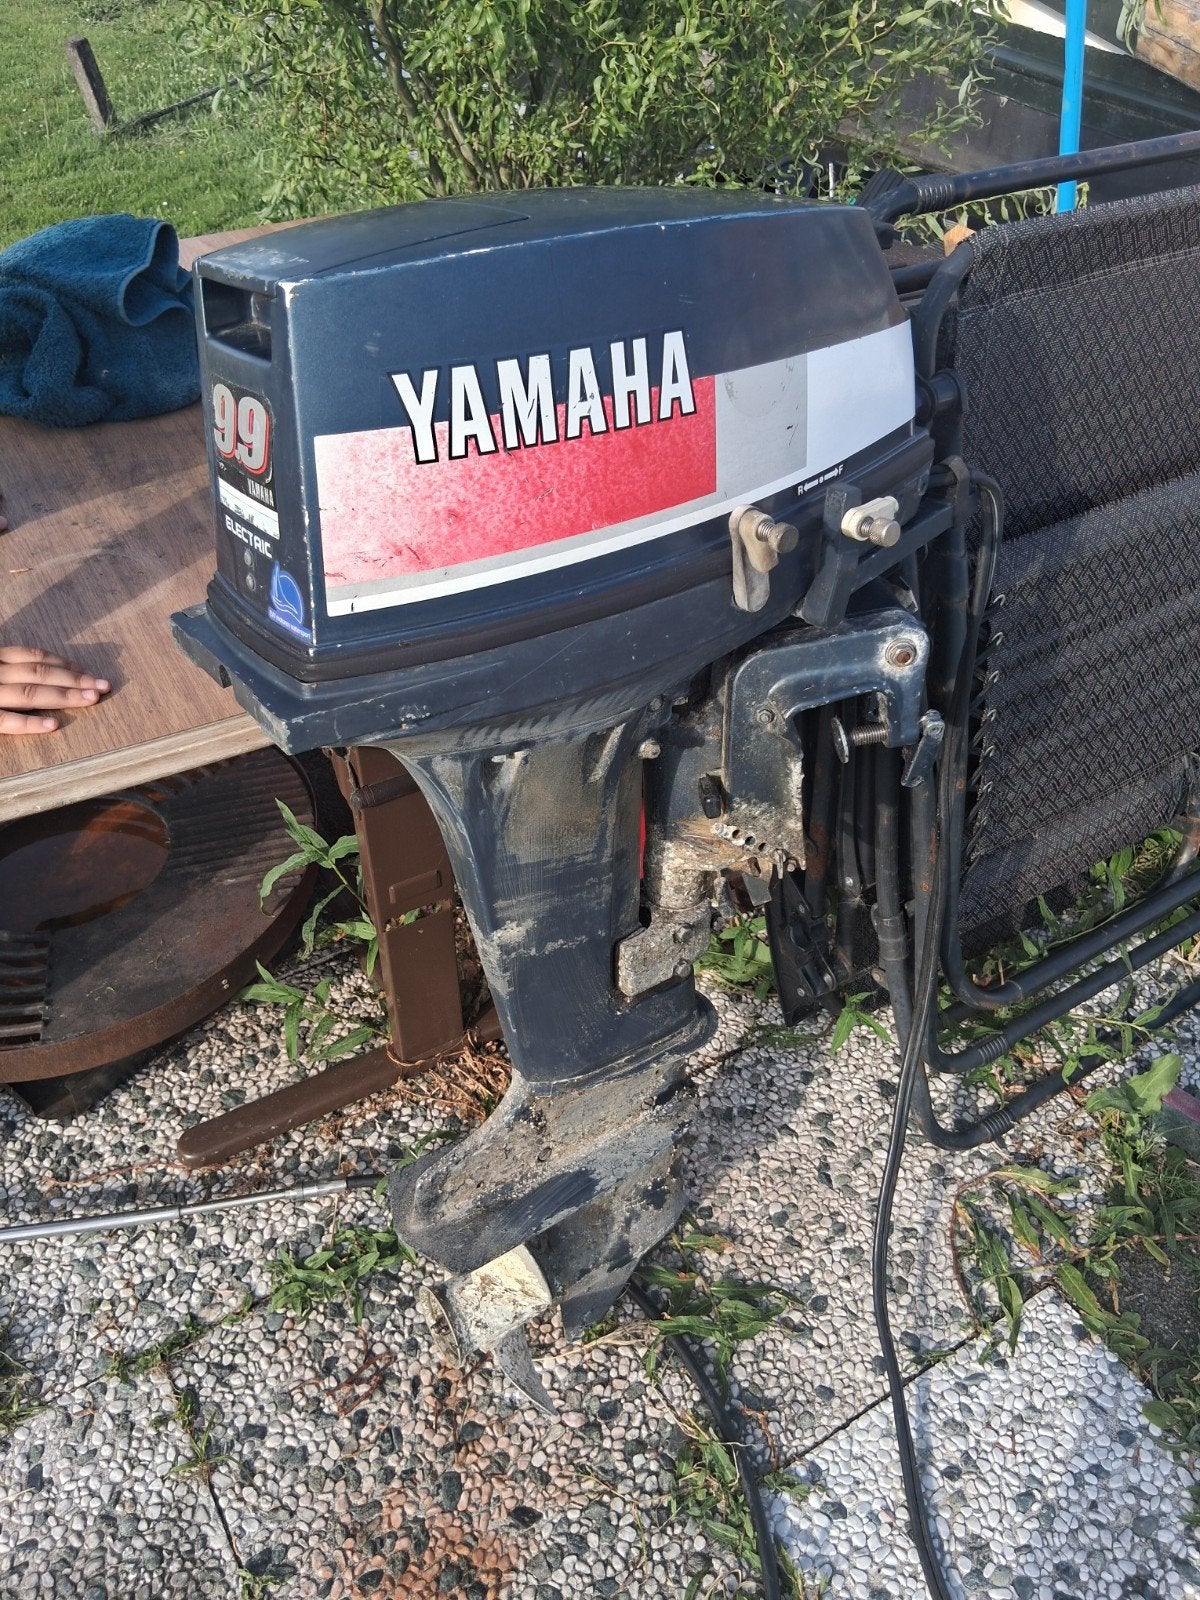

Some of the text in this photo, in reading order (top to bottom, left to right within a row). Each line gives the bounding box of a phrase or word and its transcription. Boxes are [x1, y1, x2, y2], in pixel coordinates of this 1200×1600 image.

[388, 329, 696, 464] YAMAHA
[247, 478, 274, 507] YAMAHA
[797, 464, 844, 496] R F
[225, 514, 273, 559] ELECTRIC
